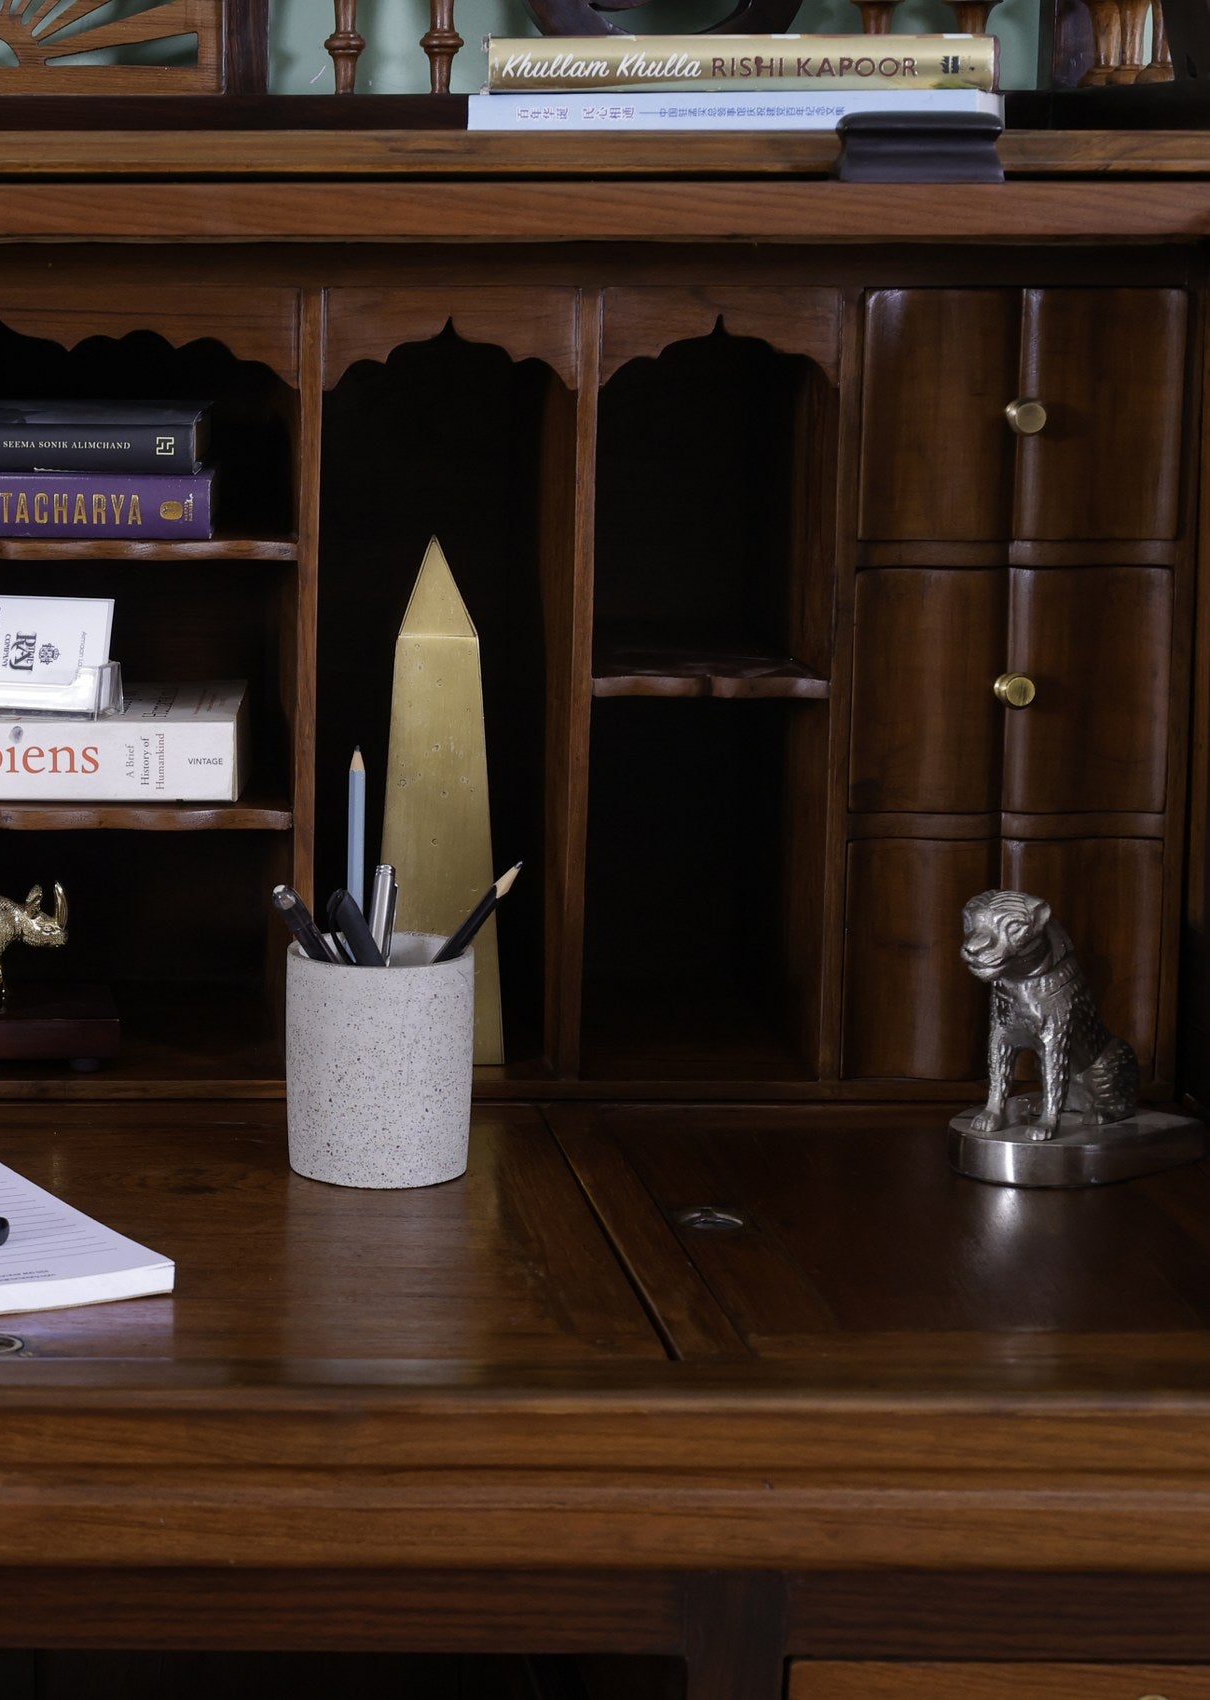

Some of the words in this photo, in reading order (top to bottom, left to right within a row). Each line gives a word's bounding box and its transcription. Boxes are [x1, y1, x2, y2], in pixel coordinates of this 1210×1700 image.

[502, 52, 609, 79] Khullam
[616, 52, 702, 79] Khulla
[711, 57, 785, 78] RISHI
[796, 57, 919, 78] KAPOOR
[518, 107, 568, 120] 百年华诞
[2, 440, 36, 449] SEEMA
[38, 440, 68, 450] SONIK
[71, 440, 131, 450] ALIMCHAND
[1, 633, 11, 668] COMPANY
[10, 631, 37, 672] RAJ
[141, 736, 149, 748] of
[125, 743, 134, 768] Brief
[156, 733, 165, 790] Humankind
[187, 757, 223, 766] VINTAGE
[125, 770, 134, 779] A
[141, 751, 152, 786] History
